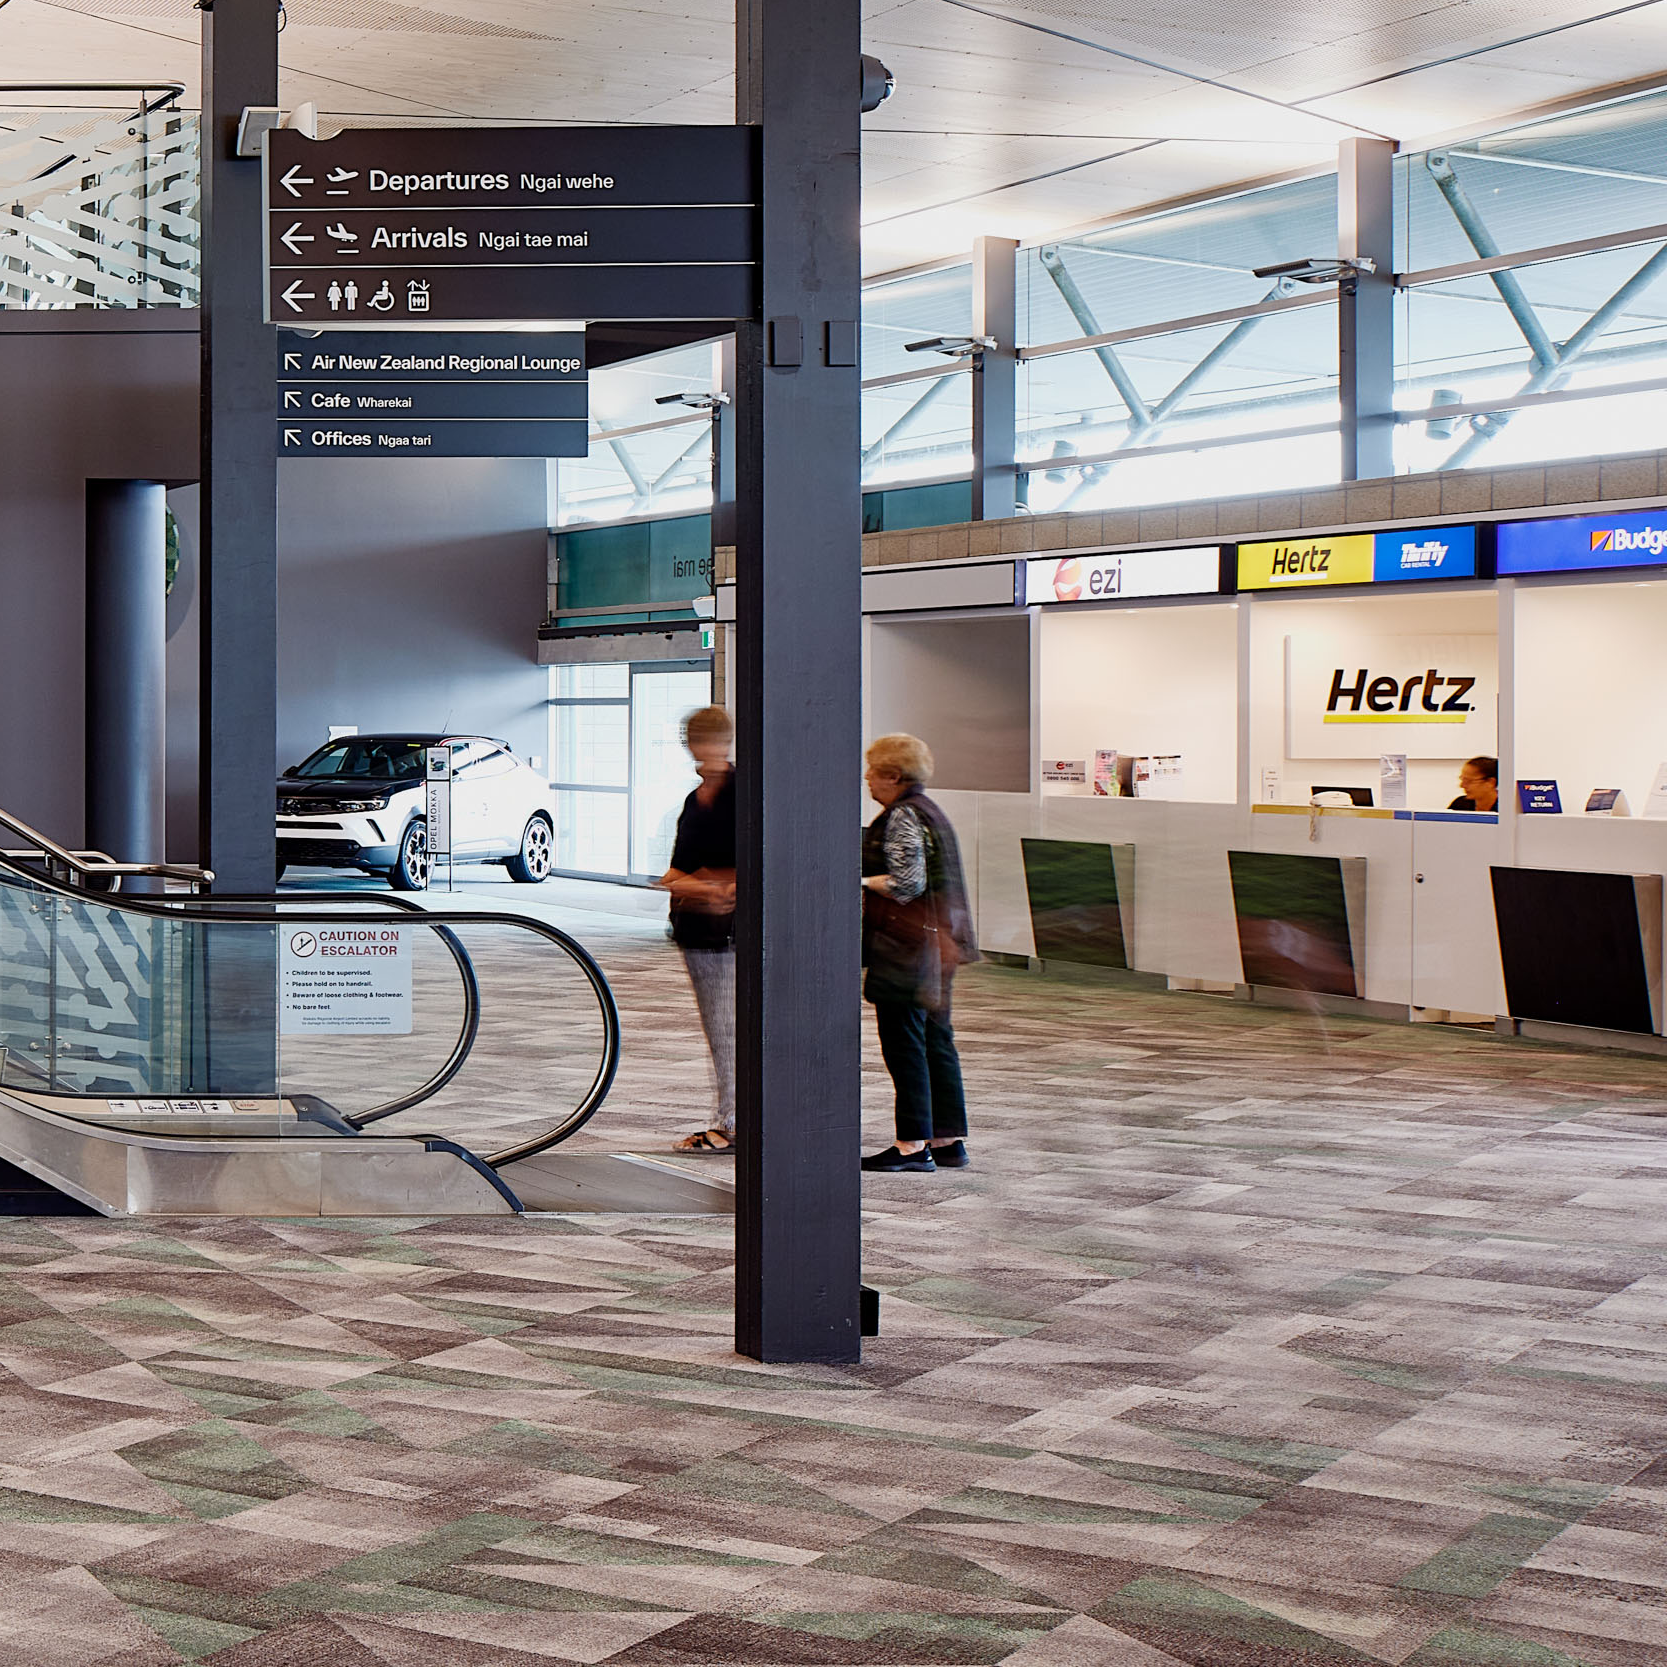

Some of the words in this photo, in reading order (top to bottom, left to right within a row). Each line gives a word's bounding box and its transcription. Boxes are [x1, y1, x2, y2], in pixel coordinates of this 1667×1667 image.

[369, 169, 510, 195] Departures
[520, 173, 562, 193] Ngai
[565, 173, 615, 190] wehe
[370, 226, 468, 249] Arrivals
[478, 231, 520, 250] Ngai
[523, 232, 553, 247] tae
[556, 231, 589, 247] mai
[311, 354, 336, 371] Air
[338, 354, 377, 371] New
[380, 354, 446, 371] Zealand
[448, 354, 518, 375] Regional
[521, 354, 581, 375] Lounge
[311, 392, 351, 409] Cafe
[357, 396, 412, 409] Wharekai
[311, 430, 372, 446] Offices
[378, 434, 409, 448] Ngaa
[412, 434, 432, 446] tari
[1271, 545, 1331, 574] Hertz
[1089, 558, 1122, 594] ezi
[319, 931, 376, 941] CAUTION
[380, 931, 399, 941] ON
[321, 945, 397, 956] ESCALATOR
